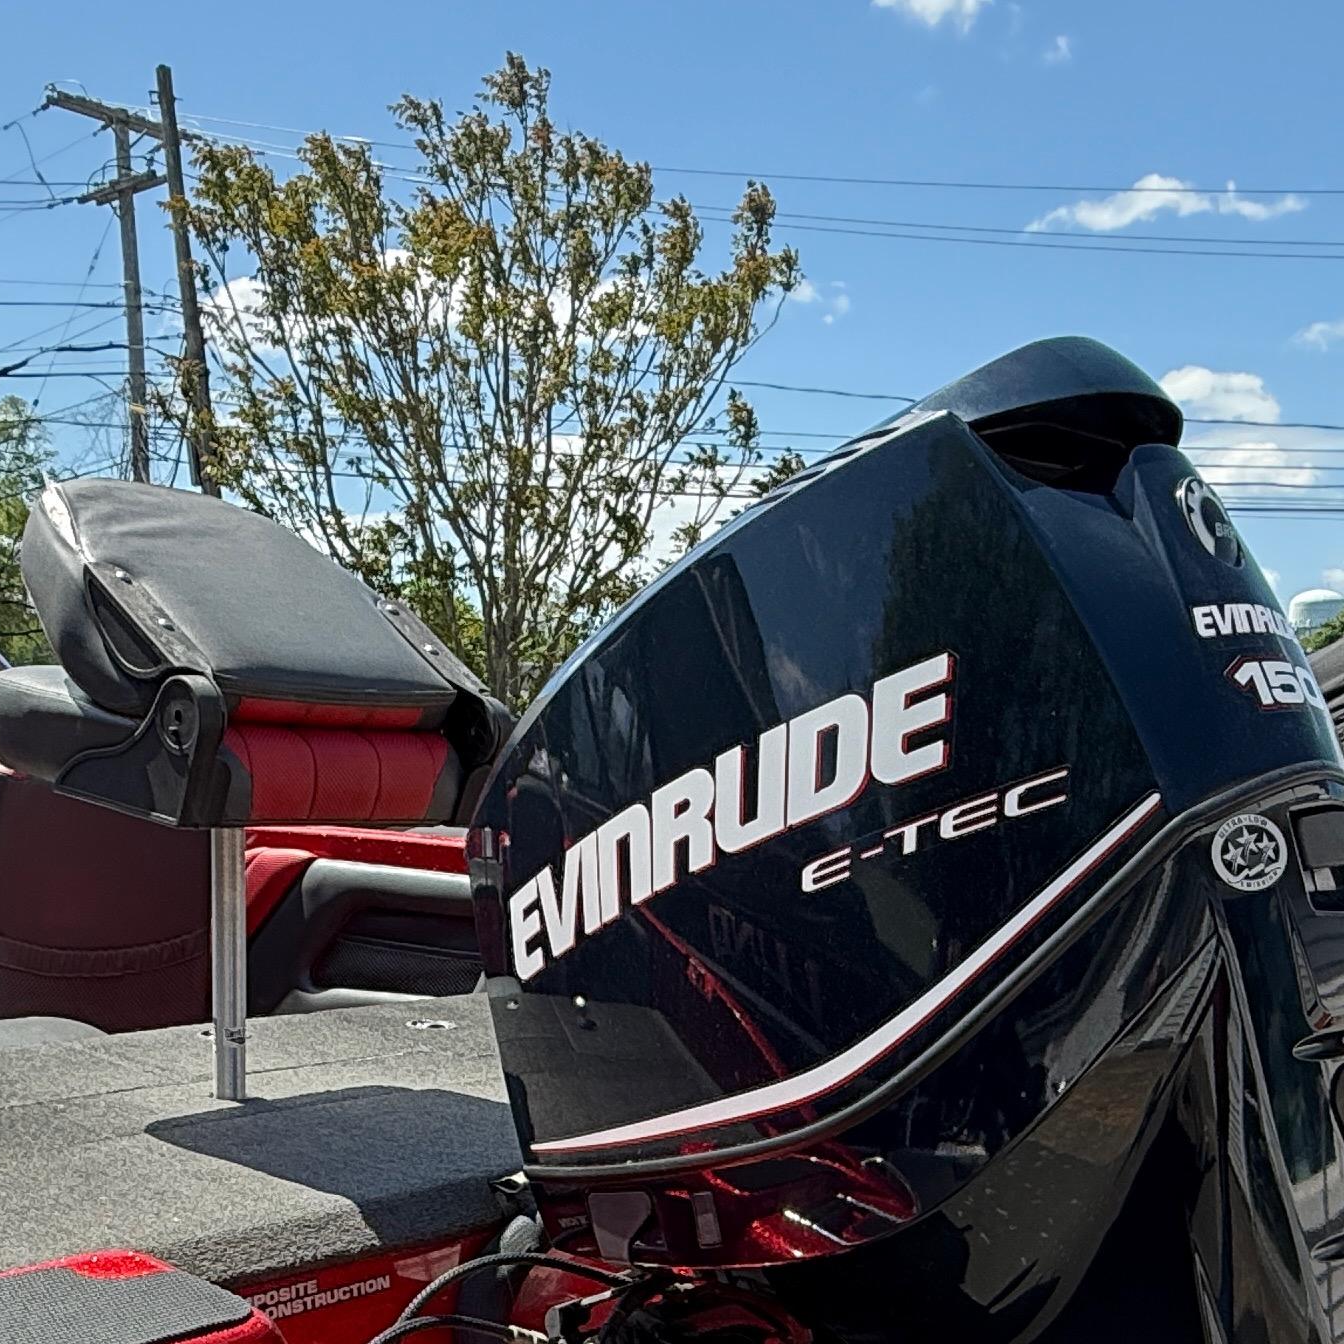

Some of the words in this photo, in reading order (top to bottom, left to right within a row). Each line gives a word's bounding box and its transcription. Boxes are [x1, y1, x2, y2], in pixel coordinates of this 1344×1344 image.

[1233, 660, 1325, 710] 150
[508, 650, 955, 982] EVINRUDE
[800, 764, 1070, 894] E-TEC
